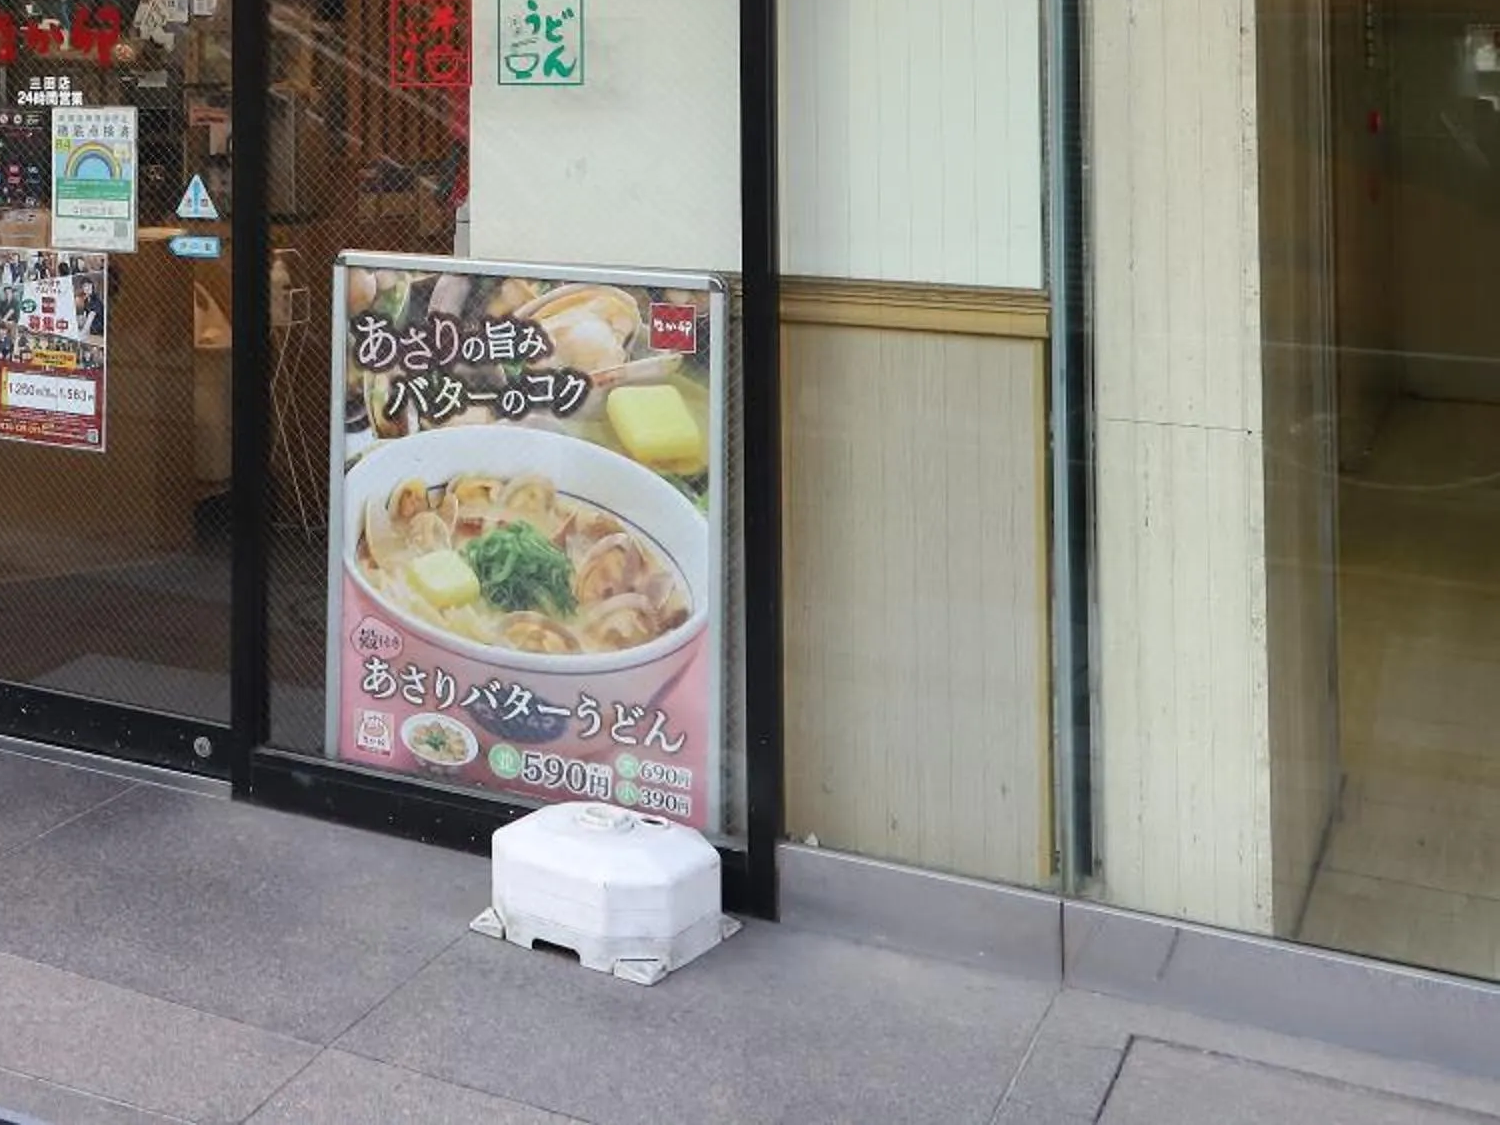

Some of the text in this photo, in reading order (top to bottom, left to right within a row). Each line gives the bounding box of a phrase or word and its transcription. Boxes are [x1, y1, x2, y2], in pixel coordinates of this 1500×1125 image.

[17, 91, 83, 106] 24時間営業
[29, 76, 71, 90] 三田店
[355, 314, 547, 371] あさりの旨み
[389, 374, 588, 419] バターのコク
[363, 656, 686, 753] あさりバターうどん
[522, 751, 612, 799] 590円
